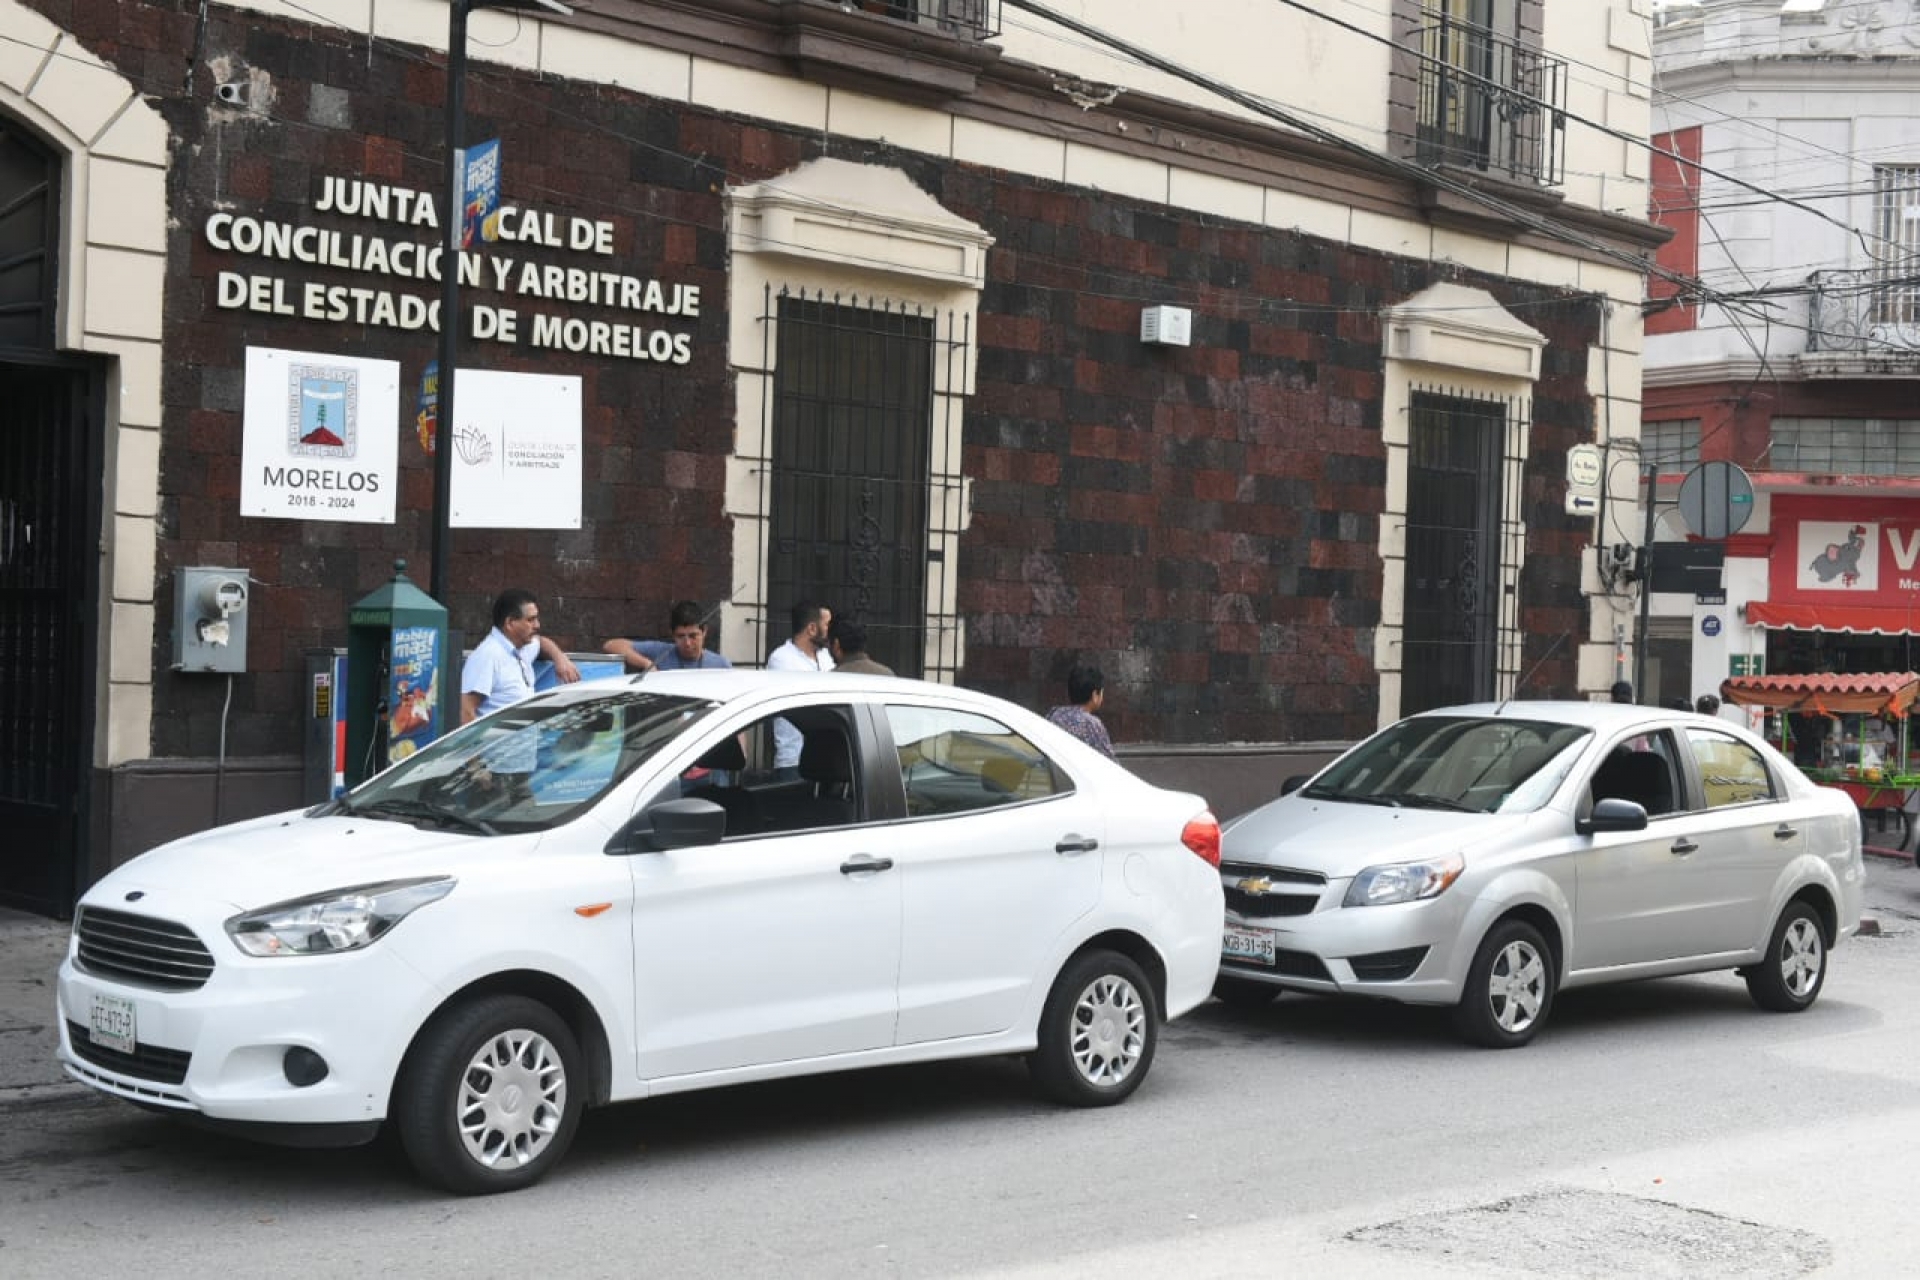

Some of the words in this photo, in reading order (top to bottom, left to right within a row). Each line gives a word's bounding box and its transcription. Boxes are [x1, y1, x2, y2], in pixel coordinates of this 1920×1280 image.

[315, 176, 438, 227] JUNTA
[498, 206, 562, 248] CAL
[569, 218, 614, 255] DE
[217, 272, 295, 316] DEL
[472, 305, 518, 342] DE
[532, 315, 692, 365] MORELOS
[491, 256, 515, 292] Y
[518, 262, 701, 319] ARBITRAJE
[263, 466, 379, 493] MORELOS
[287, 494, 316, 507] 2018
[327, 496, 356, 508] 2024
